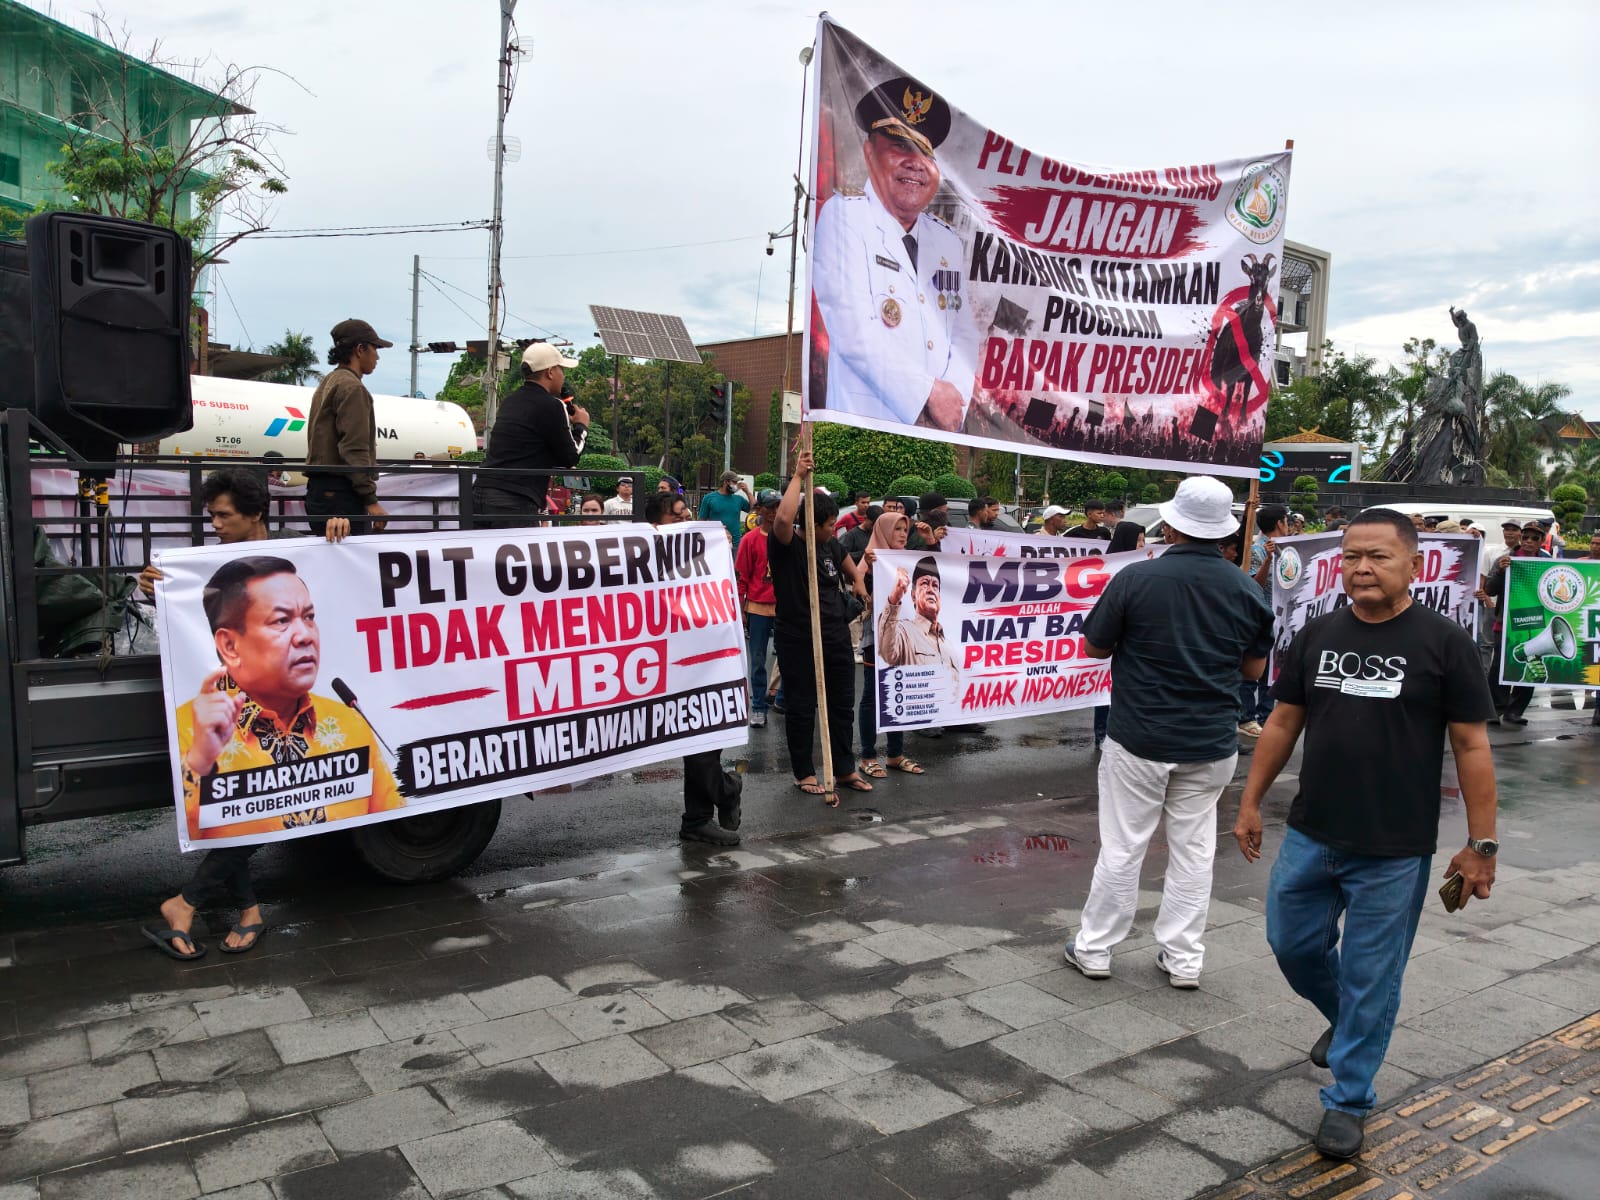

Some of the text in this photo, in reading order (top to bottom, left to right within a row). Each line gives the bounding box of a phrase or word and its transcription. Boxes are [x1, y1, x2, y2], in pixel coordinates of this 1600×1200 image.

[977, 129, 1031, 176] PLT
[1024, 195, 1182, 256] JANGAN
[969, 231, 1221, 305] KAMBING HITAMKAN
[1043, 295, 1163, 340] PROGRAM
[981, 336, 1207, 395] BAPAK PRESIDEN
[192, 399, 249, 411] PG SUBSIDI
[215, 436, 242, 444] ST.06
[378, 532, 711, 608] PLT GUBERNUR
[962, 558, 1111, 604] MBG
[356, 578, 738, 673] TIDAK MENDUKUNG
[961, 616, 1036, 643] NIAT
[1018, 603, 1062, 615] ADALAH
[516, 646, 660, 716] MBG
[1026, 665, 1058, 676] UNTUK
[1318, 650, 1407, 681] BOSS
[961, 669, 1113, 711] ANAK INDONESIA
[411, 685, 748, 789] BERARTI MELAWAN PRESIDEN
[212, 753, 360, 799] SF HARYANTO
[222, 782, 355, 818] Plt GUBERNUR RIAU
